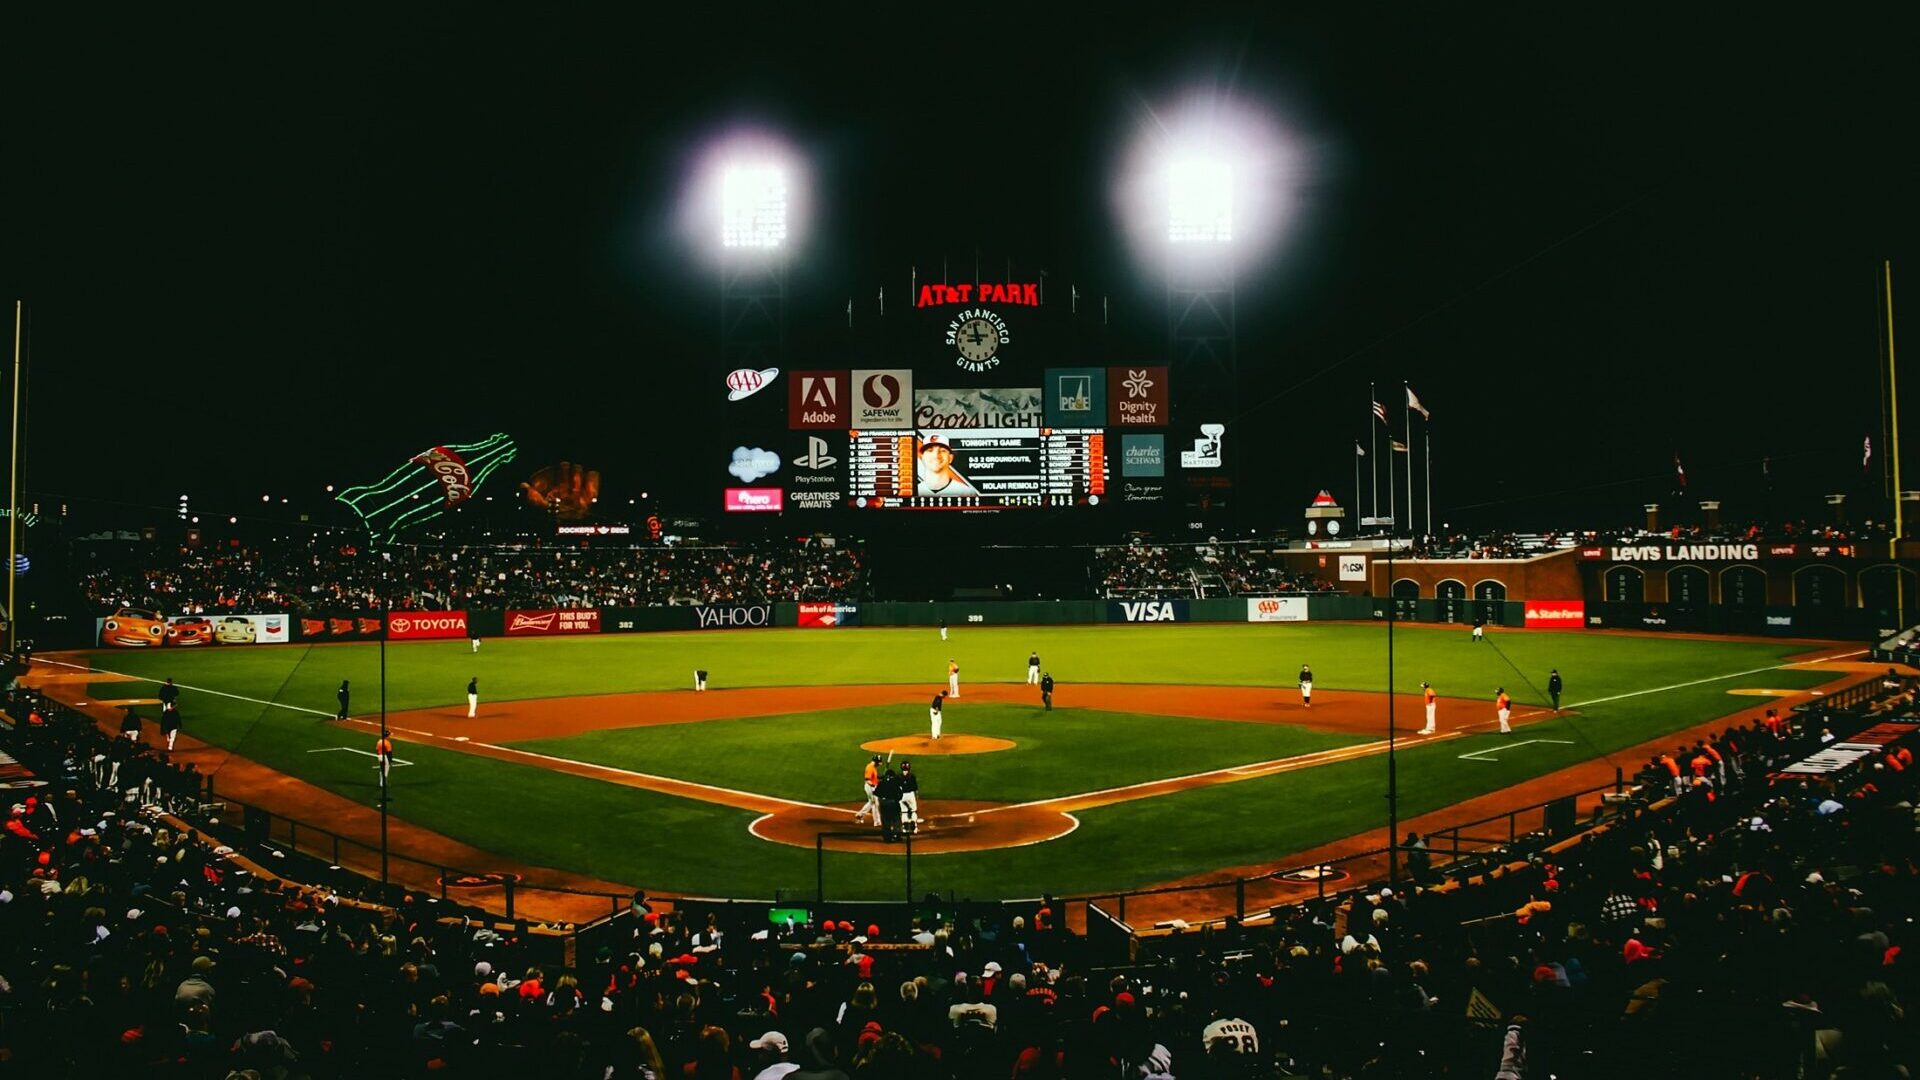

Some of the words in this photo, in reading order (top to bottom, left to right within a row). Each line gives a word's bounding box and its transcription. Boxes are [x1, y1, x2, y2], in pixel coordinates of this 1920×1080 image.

[917, 284, 973, 307] AT&T
[979, 283, 1038, 306] PARK
[946, 320, 960, 345] SAN
[958, 308, 1010, 344] FRANCISCO
[956, 356, 1000, 372] GIANTS
[729, 371, 762, 391] AAA
[862, 409, 900, 417] SAFEWAY
[1119, 401, 1157, 413] Dignity
[802, 412, 836, 423] Adobe
[916, 405, 981, 428] Coors
[984, 412, 1042, 428] LIGHT
[1121, 414, 1156, 423] Health
[1126, 446, 1160, 456] charles
[434, 461, 470, 502] Cola
[982, 482, 1007, 490] NOLAN
[790, 492, 840, 500] GREATNESS
[1666, 544, 1758, 560] LANDING
[1350, 563, 1364, 572] CSN
[559, 612, 574, 621] THIS
[576, 612, 597, 620] BUD'S
[696, 605, 770, 628] YAHOO!
[1119, 602, 1175, 622] VISA
[414, 618, 466, 630] TOYOTA
[559, 622, 574, 630] FOR
[575, 621, 590, 630] YOU.
[1220, 1024, 1250, 1034] POSEY
